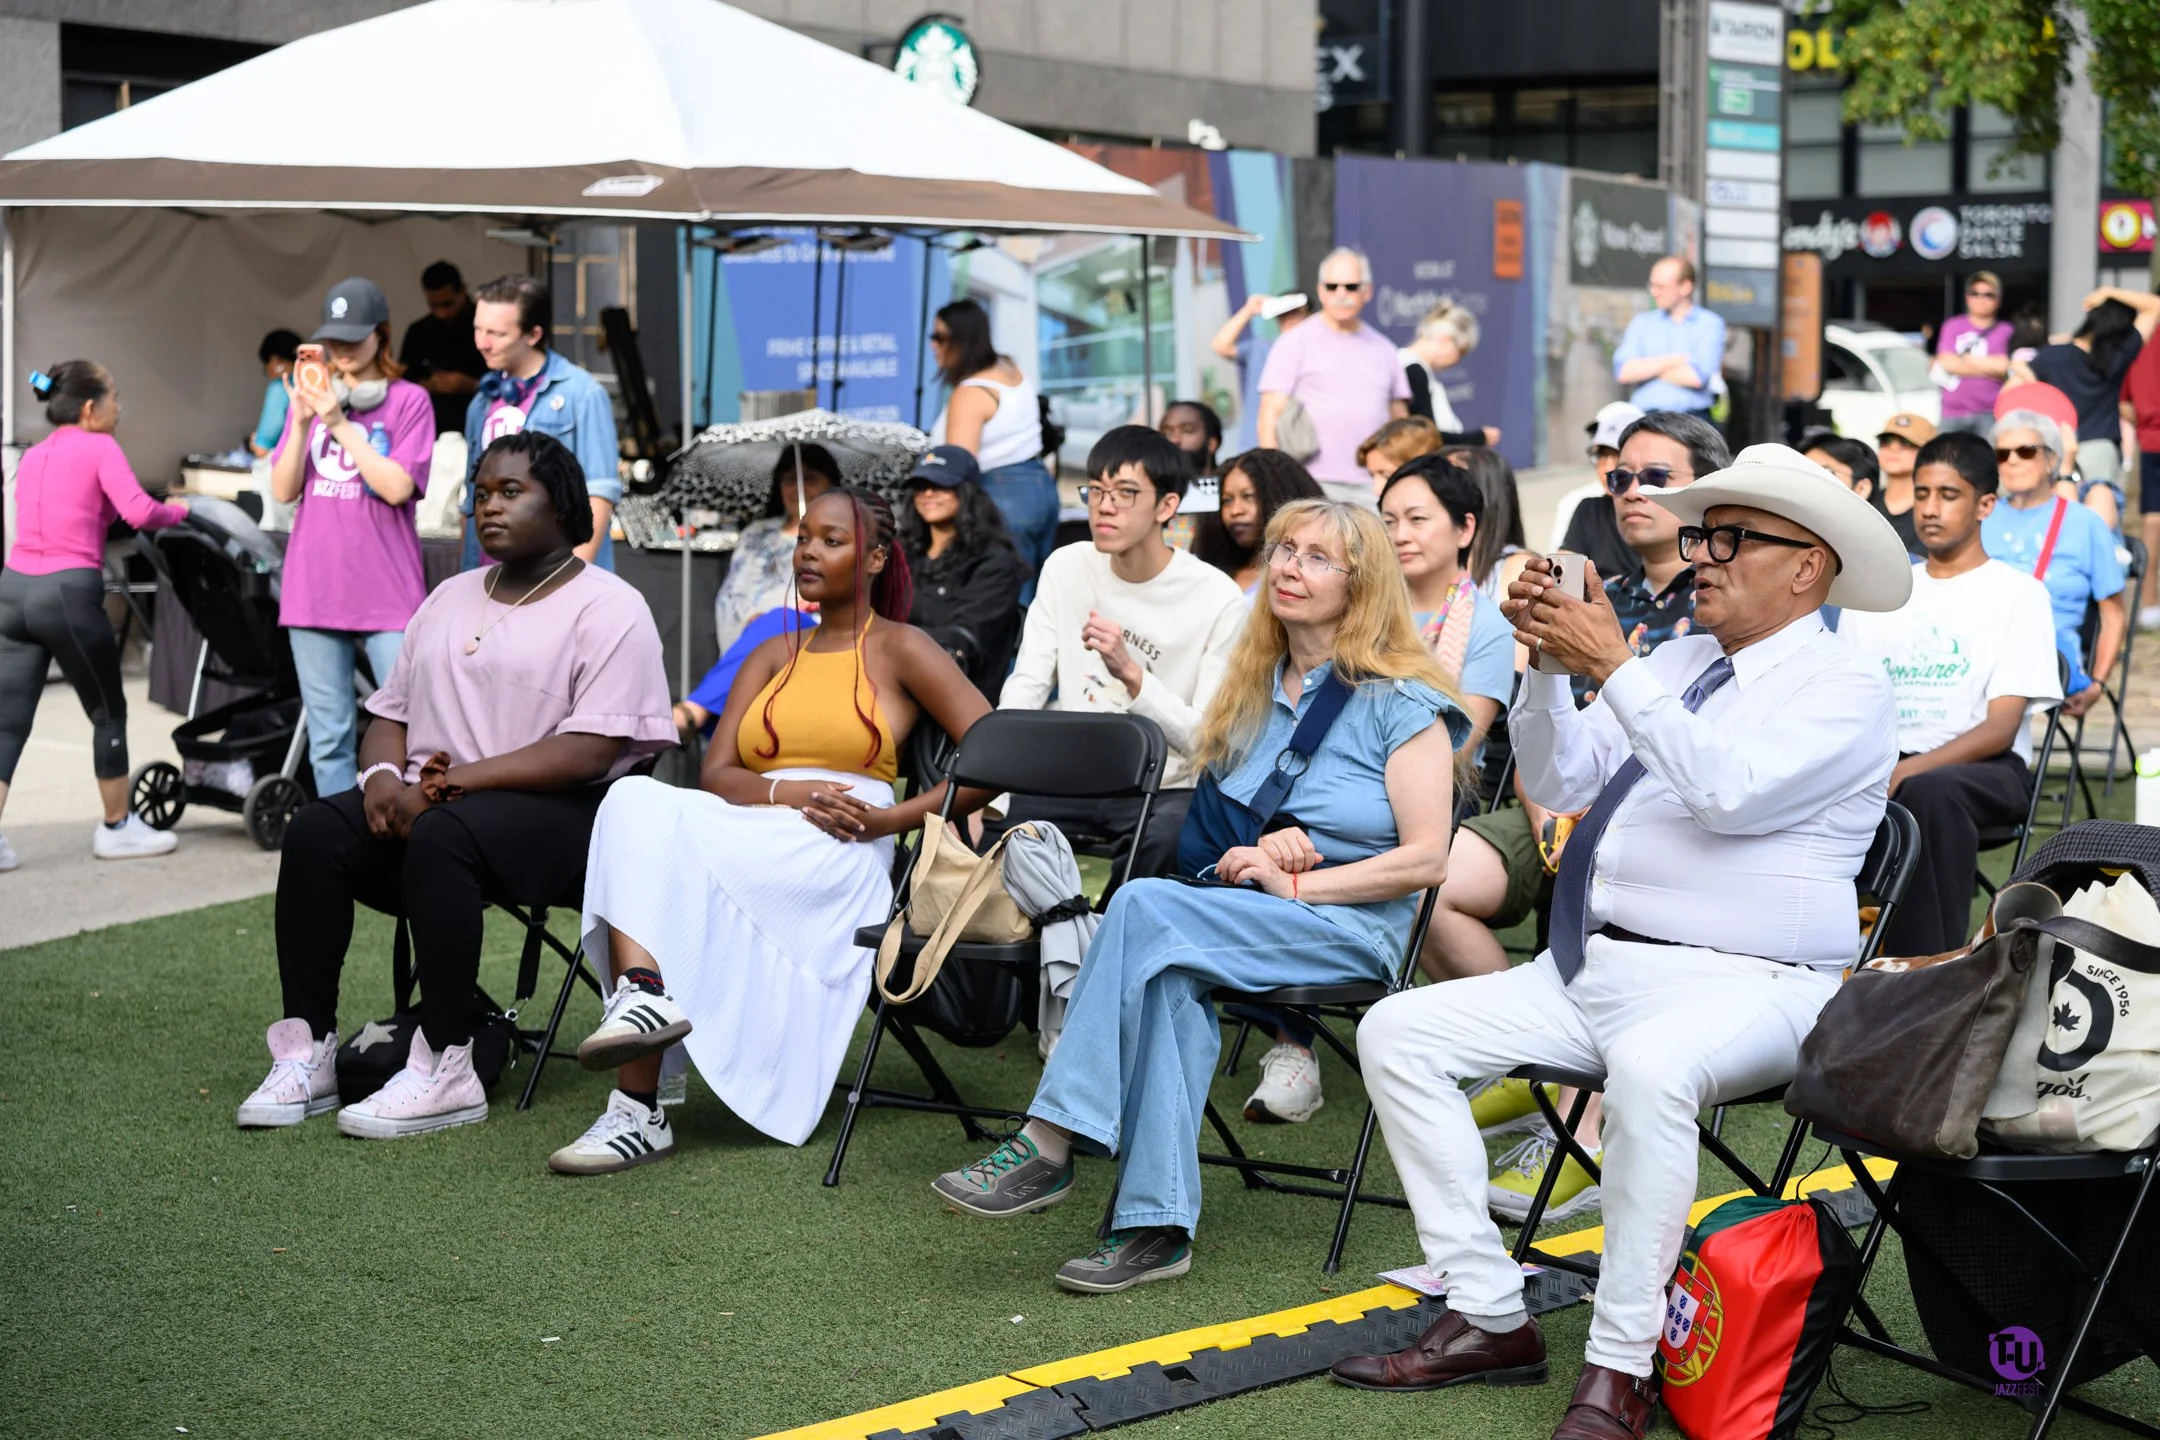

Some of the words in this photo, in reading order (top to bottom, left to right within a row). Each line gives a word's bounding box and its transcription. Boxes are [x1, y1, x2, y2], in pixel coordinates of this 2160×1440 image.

[312, 479, 361, 499] JAZZFEST
[2086, 964, 2121, 986] SINCE
[2115, 984, 2130, 1018] 1956
